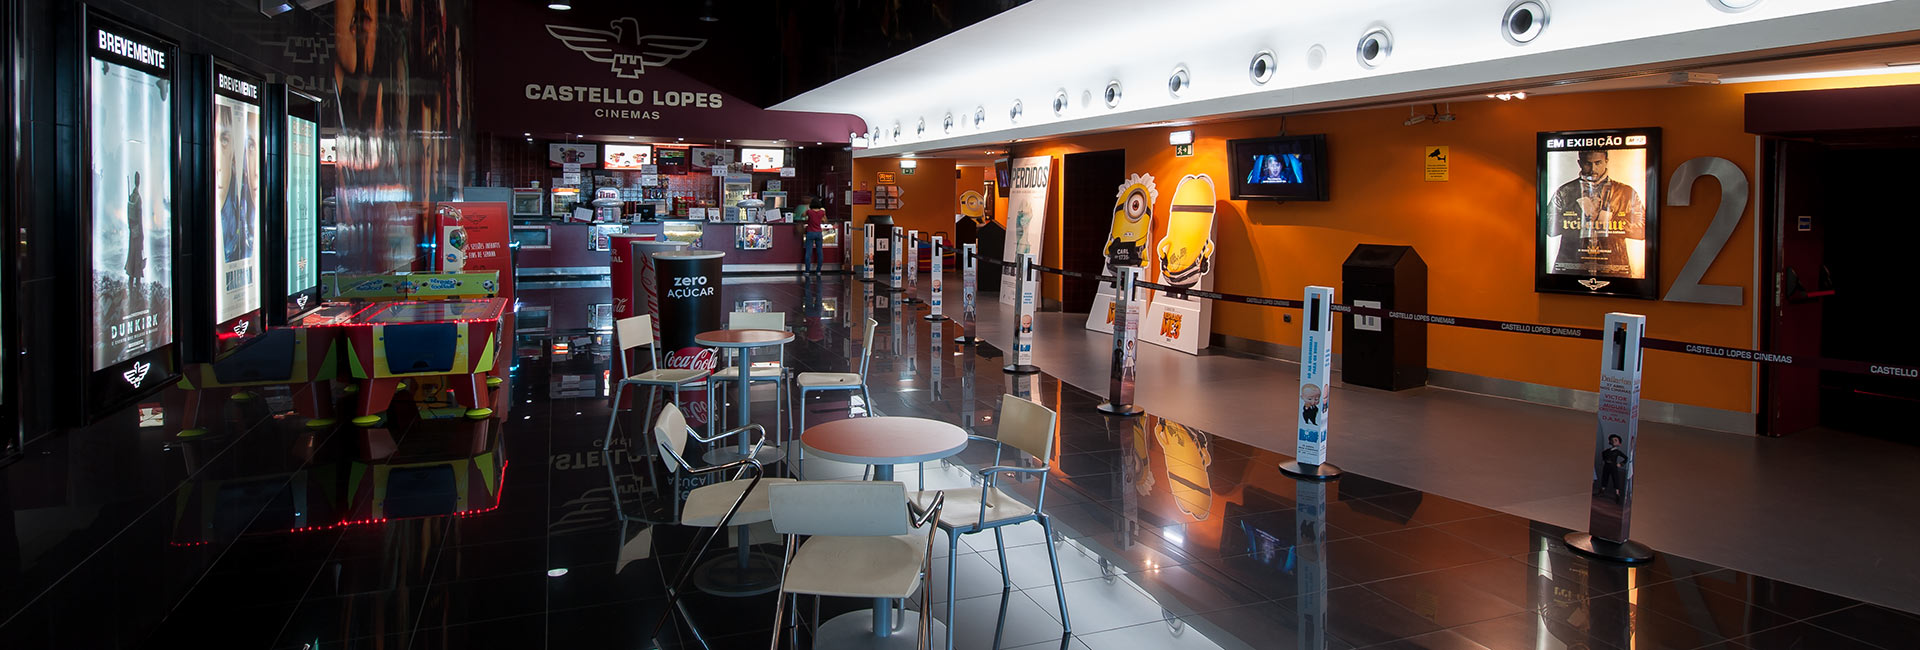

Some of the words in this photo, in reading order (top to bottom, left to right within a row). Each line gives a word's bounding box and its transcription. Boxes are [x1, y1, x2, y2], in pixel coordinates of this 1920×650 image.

[98, 29, 165, 69] BREVEMENTE
[219, 73, 258, 99] BREVEMENTE
[525, 84, 644, 105] CASTELLO
[653, 90, 723, 108] LOPES
[594, 108, 660, 120] CINEMAS
[1546, 139, 1564, 148] EM
[1567, 136, 1622, 147] EXIBIÇÃO
[1010, 166, 1049, 188] PERDIDOS
[1662, 156, 1750, 306] 2
[674, 275, 708, 287] zero
[667, 286, 715, 300] AÇÚCAR
[111, 314, 158, 339] DUNKIRK
[1389, 311, 1414, 320] CASTELLO
[1414, 314, 1430, 322] LOPES
[1430, 316, 1456, 325] CINEMAS
[1501, 323, 1531, 332] CASTELLO
[1531, 326, 1552, 335] LOPES
[1552, 327, 1581, 337] CINEMAS
[1686, 344, 1724, 356] CASTELLO
[1726, 348, 1751, 359] LOPES
[1753, 352, 1792, 364] CINEMAS
[1870, 365, 1918, 378] CASTELLO
